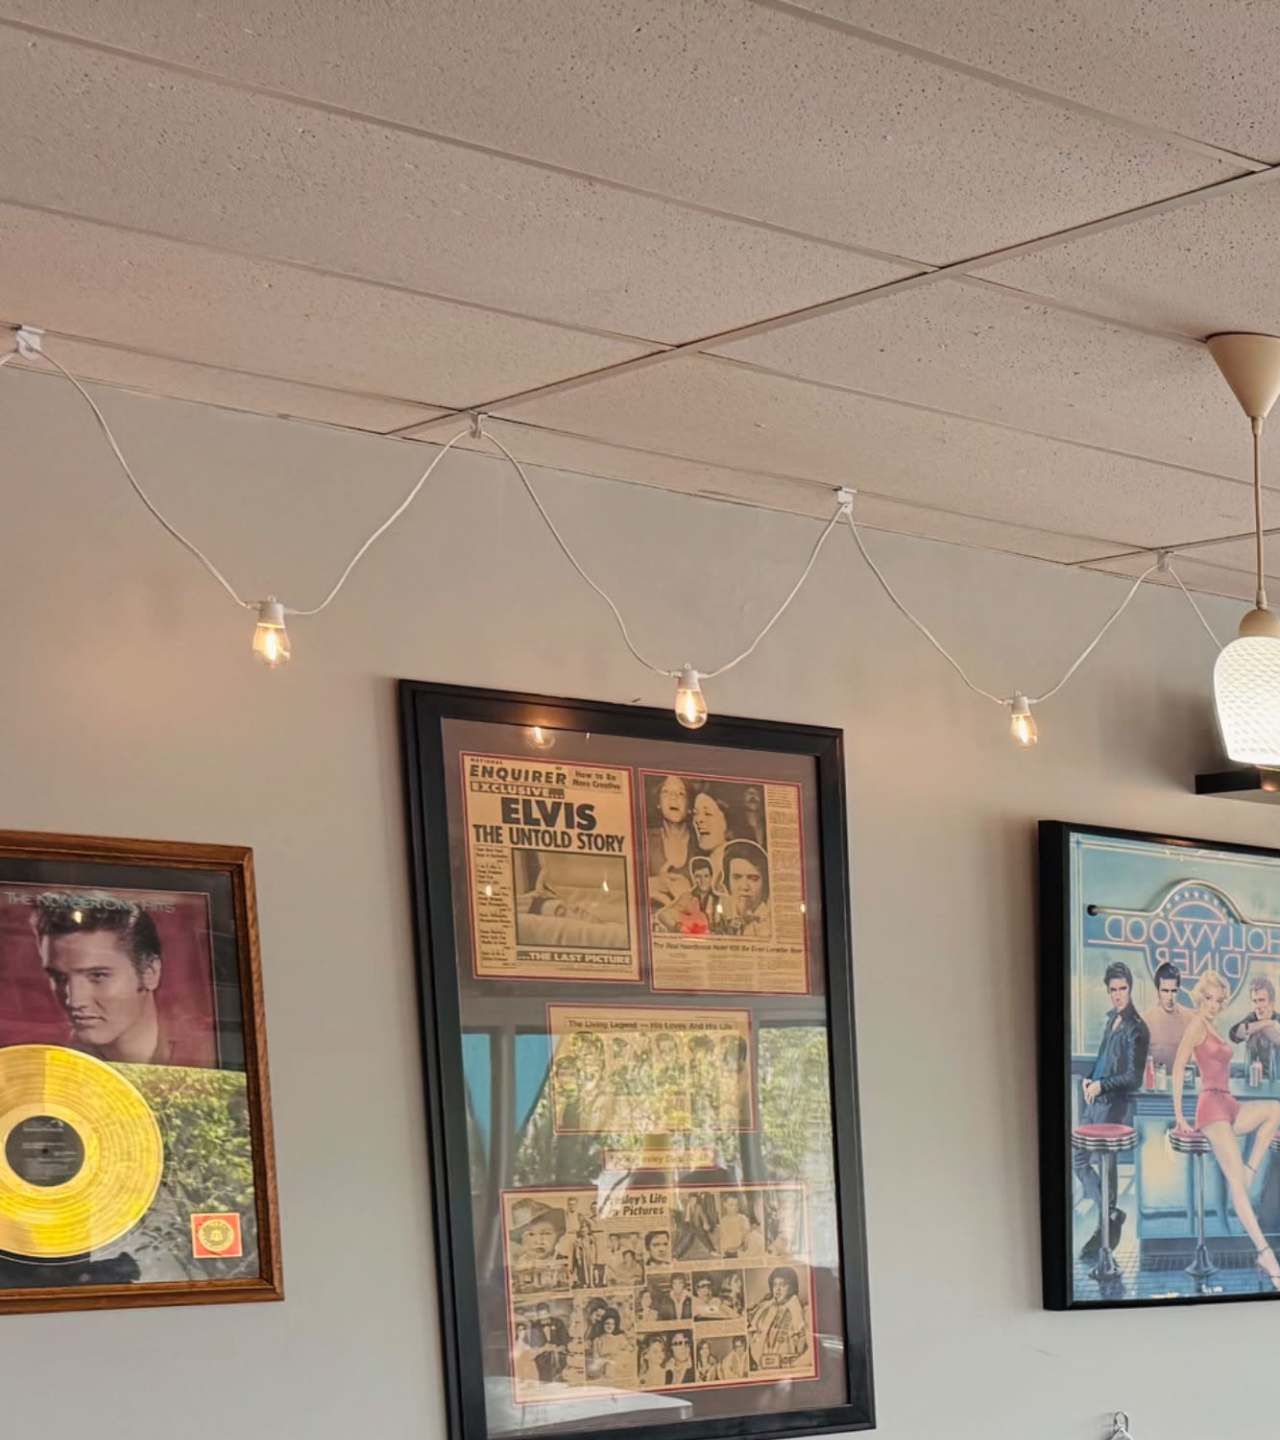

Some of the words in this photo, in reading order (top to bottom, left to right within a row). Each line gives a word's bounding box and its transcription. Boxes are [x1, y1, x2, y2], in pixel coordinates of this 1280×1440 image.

[470, 765, 567, 785] ENQUIRER
[501, 797, 598, 831] ELVIS
[473, 824, 503, 844] THE
[509, 827, 572, 848] UNTOLD
[577, 832, 625, 852] STORY
[554, 953, 583, 962] LAST
[585, 955, 631, 964] PICTURE
[568, 1020, 582, 1028] The
[610, 1022, 637, 1030] Legend
[622, 1206, 665, 1216] Pictures
